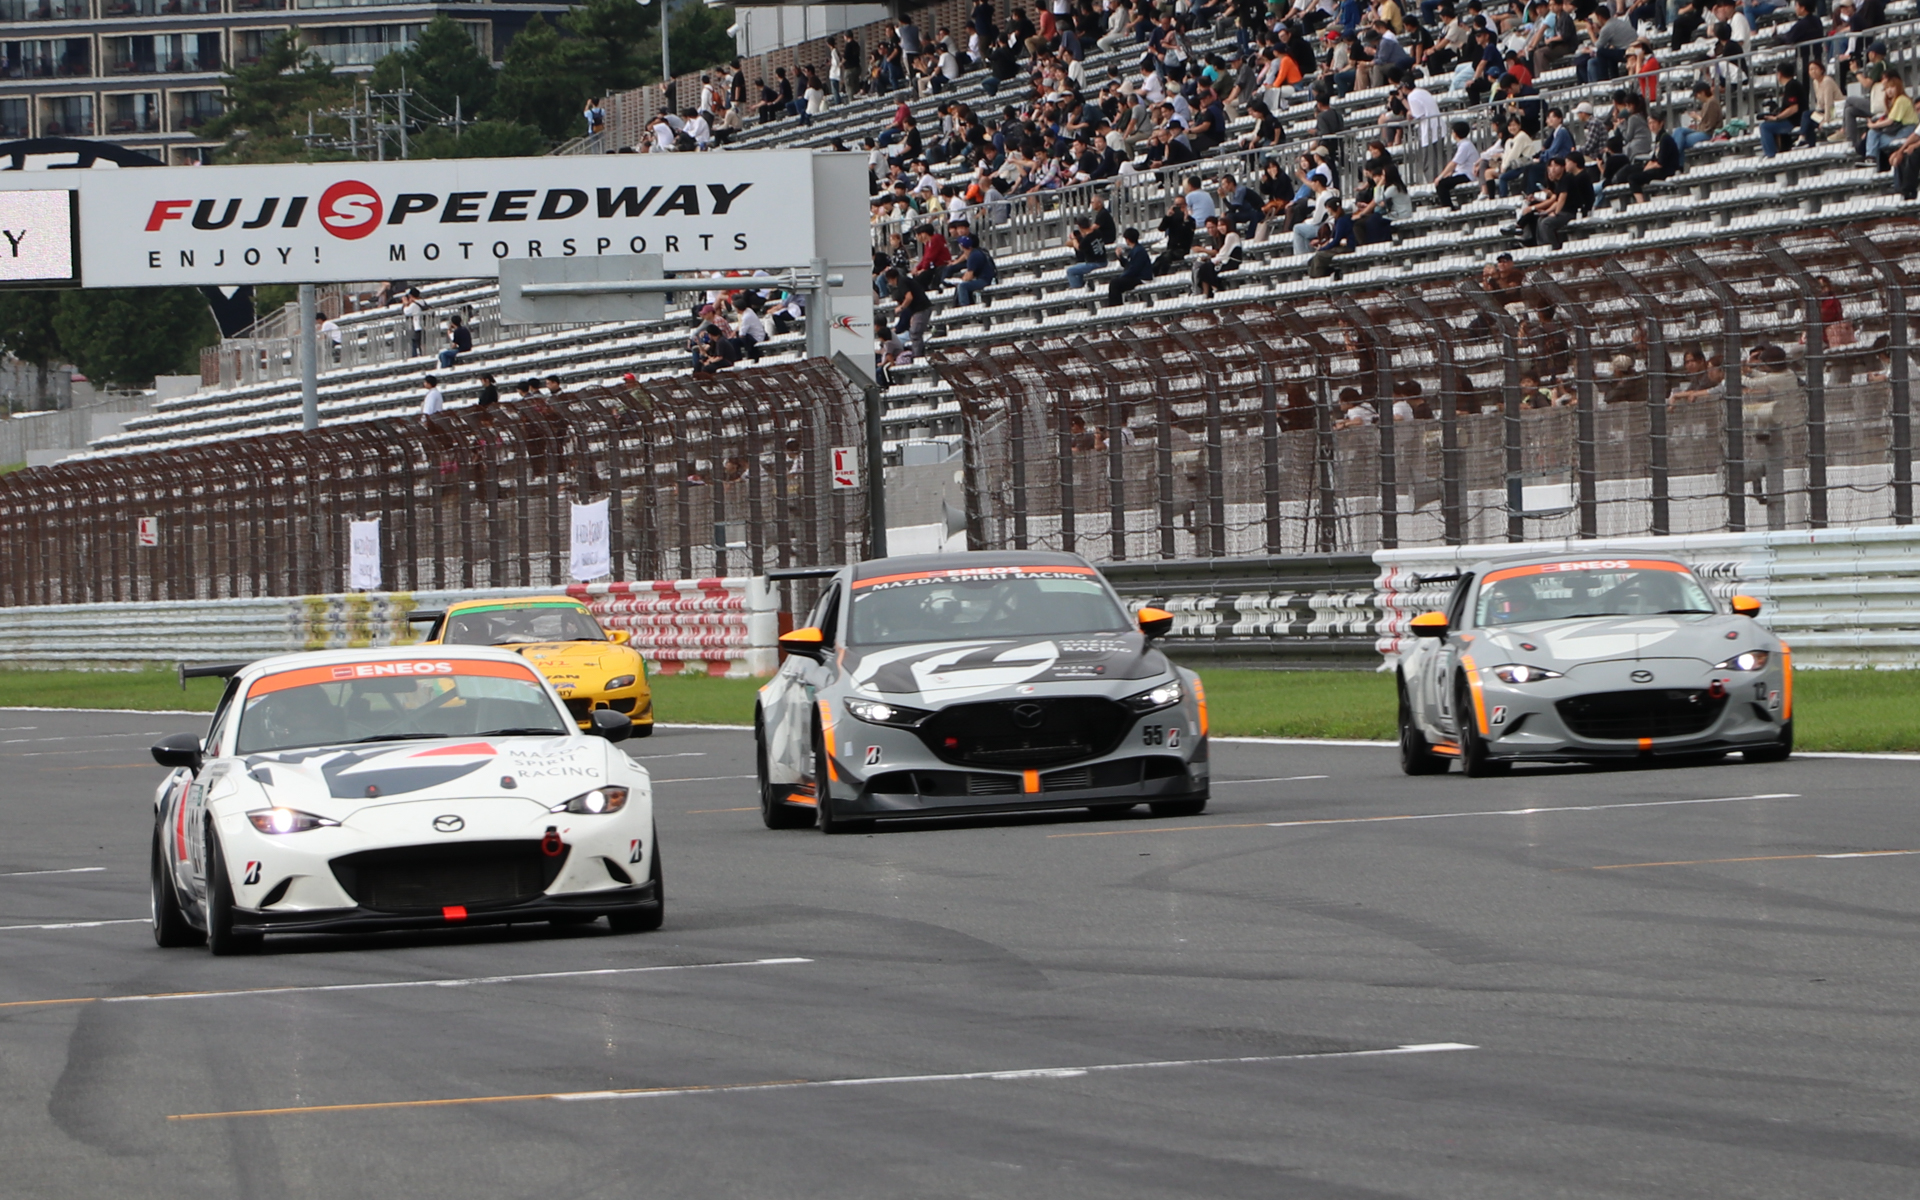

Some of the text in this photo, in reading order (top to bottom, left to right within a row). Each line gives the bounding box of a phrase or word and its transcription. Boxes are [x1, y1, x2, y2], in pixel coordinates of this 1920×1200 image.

[145, 183, 754, 231] FUJI SPEEDWAY
[149, 232, 748, 268] ENJOY! MOTORSPORTS
[946, 566, 1022, 577] ENEOS
[1559, 560, 1631, 571] ENEOS
[872, 571, 1088, 591] MAZDA SPIRIT RACING
[356, 661, 453, 677] ENEOS
[1753, 682, 1767, 701] 12
[1143, 724, 1163, 746] 55
[509, 744, 589, 758] MAZDA
[514, 754, 576, 767] SPIRIT
[518, 766, 600, 778] RACING
